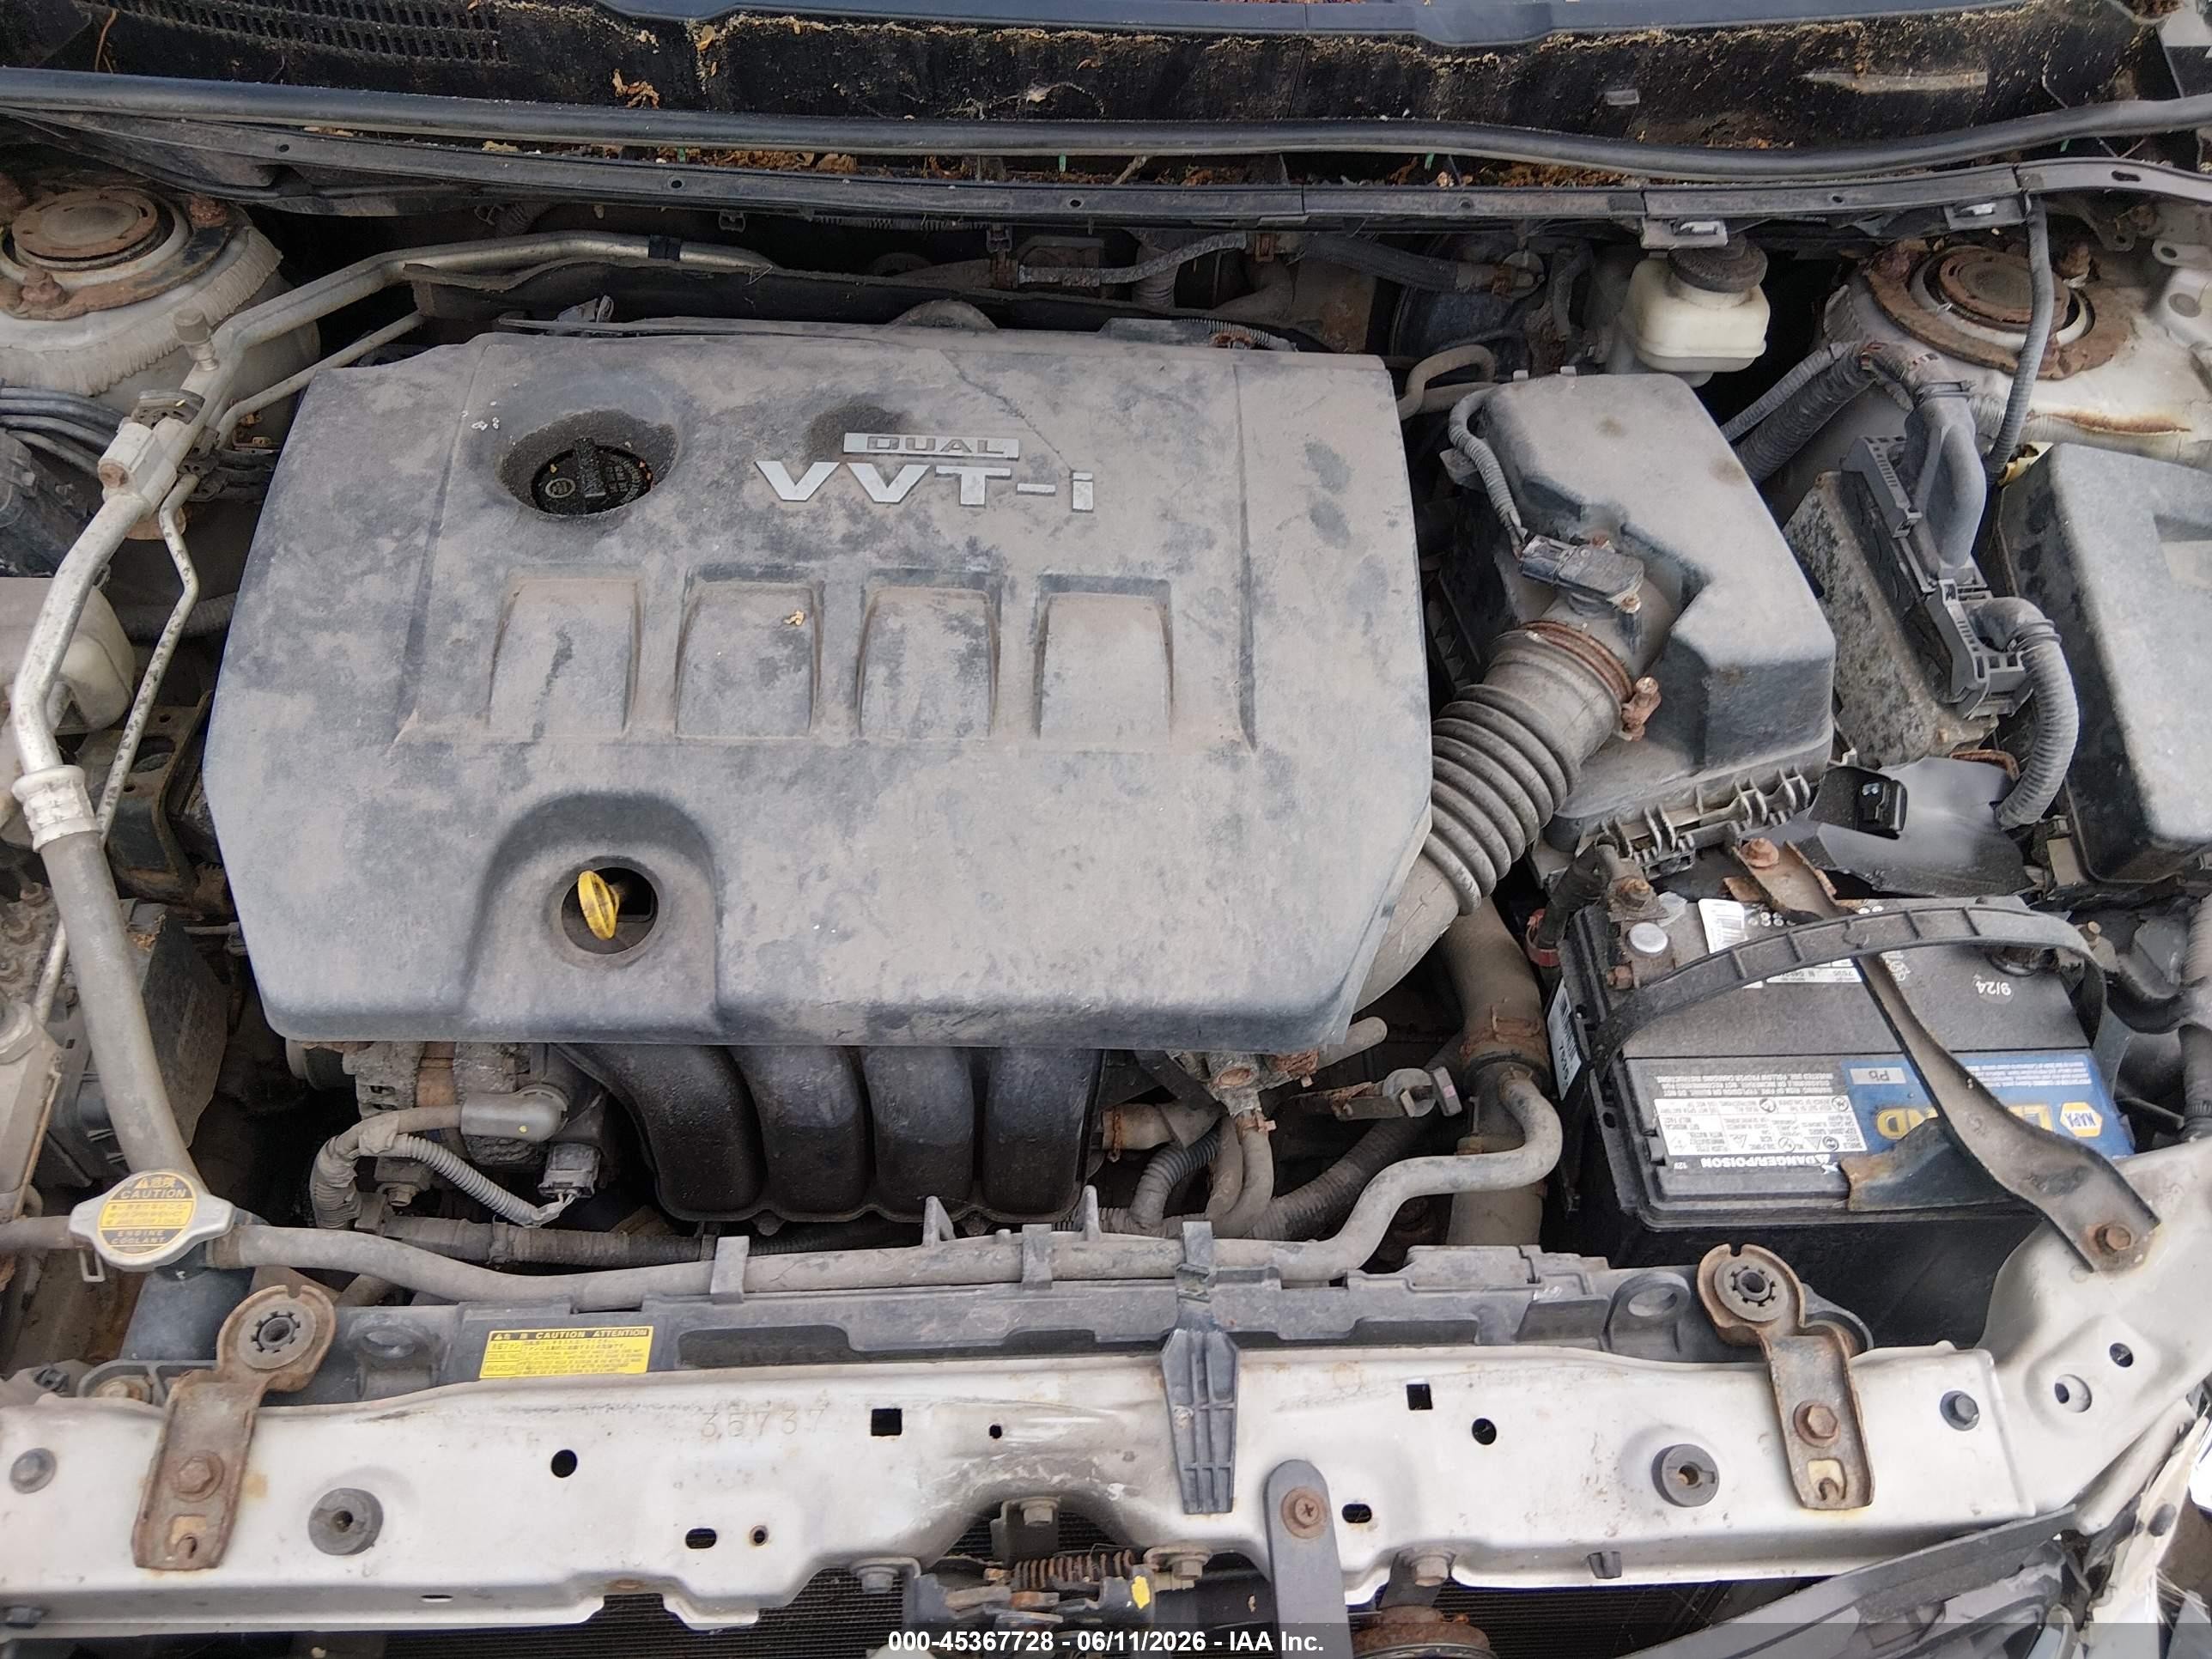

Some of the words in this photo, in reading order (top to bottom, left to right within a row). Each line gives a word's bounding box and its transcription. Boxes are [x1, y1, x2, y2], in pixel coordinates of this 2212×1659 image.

[866, 435, 1006, 455] DUAL
[754, 460, 1094, 513] VVT-i
[1976, 980, 2012, 996] 9/24
[1869, 1070, 1890, 1082] Pb
[2067, 1113, 2096, 1128] NAPA
[1700, 1154, 1816, 1169] DANGER/POISON
[119, 1188, 186, 1200] CAUTION
[535, 1331, 586, 1340] CAUTION
[592, 1328, 648, 1337] ATTENTION
